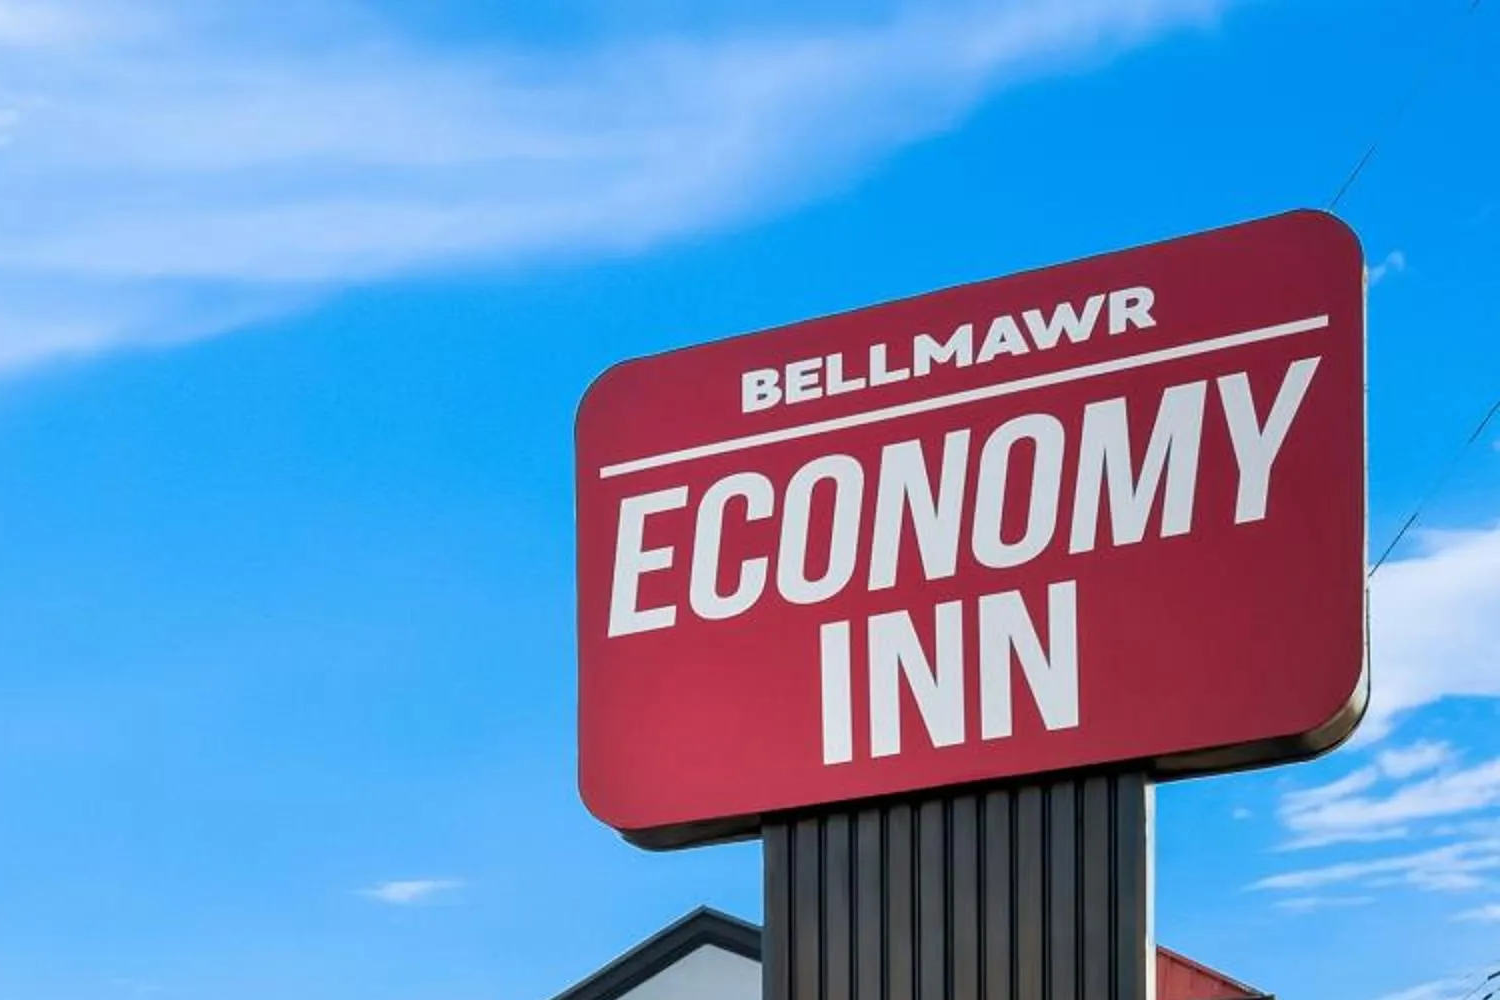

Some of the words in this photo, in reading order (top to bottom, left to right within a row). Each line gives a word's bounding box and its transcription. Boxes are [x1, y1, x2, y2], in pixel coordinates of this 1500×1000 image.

[741, 287, 1156, 413] BELLMAWR
[608, 356, 1322, 638] ECONOMY
[820, 581, 1079, 766] INN
